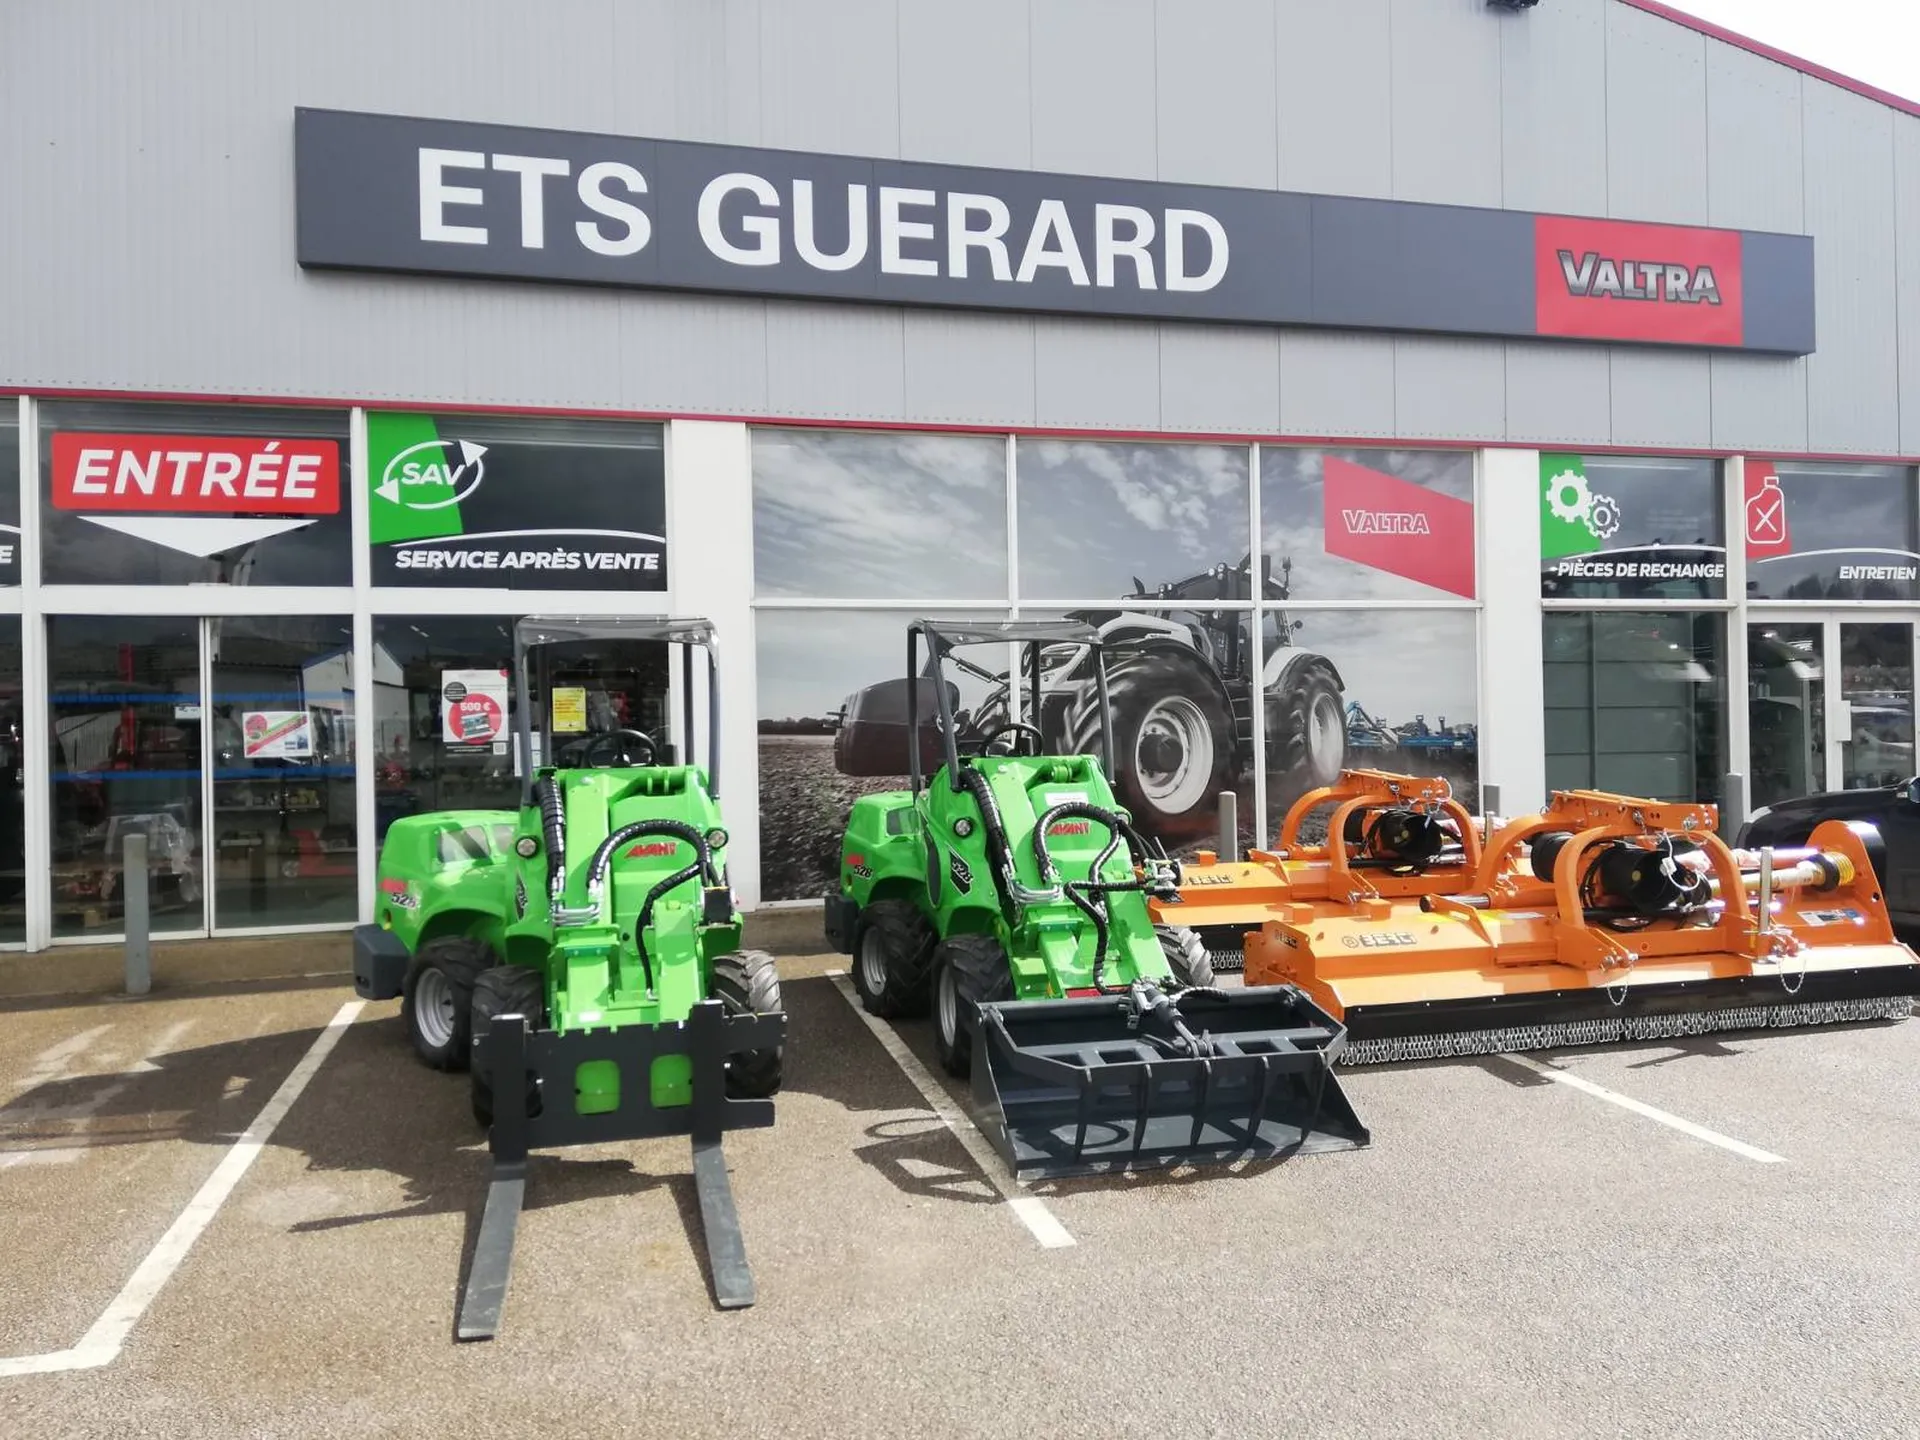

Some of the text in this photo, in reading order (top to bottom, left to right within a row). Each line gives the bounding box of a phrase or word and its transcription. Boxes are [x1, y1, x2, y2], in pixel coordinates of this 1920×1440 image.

[419, 147, 1230, 292] ETS GUERARD
[1556, 249, 1722, 306] VALTRA
[72, 441, 322, 499] ENTRÉE
[401, 463, 466, 485] SAV
[1342, 509, 1430, 534] VALTRA
[395, 547, 660, 570] SERVICE APRÈS VENTE
[1557, 558, 1725, 579] PIÈCES DE RECHANGE
[1839, 565, 1917, 580] ENTRETIEN
